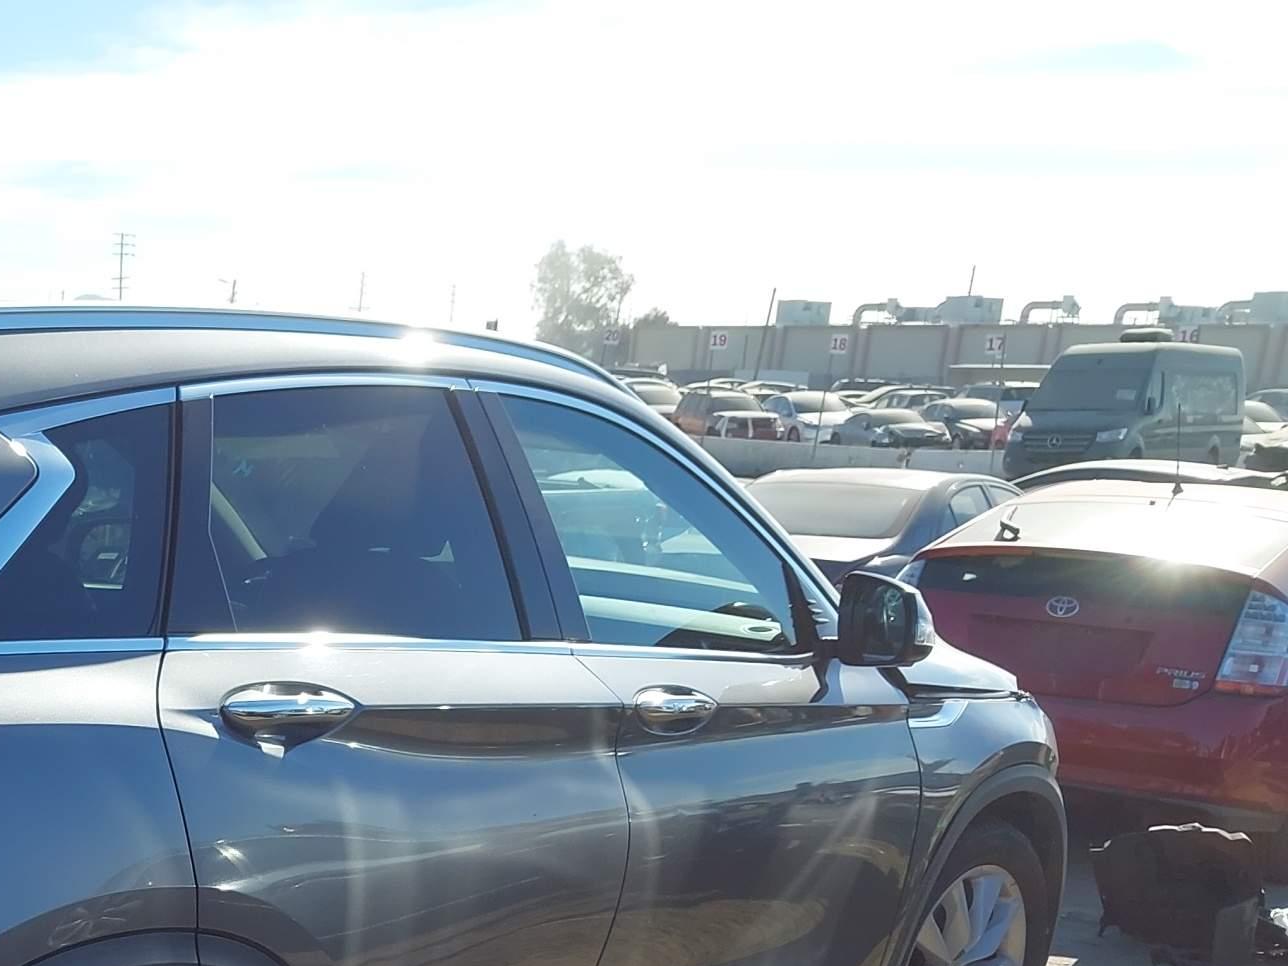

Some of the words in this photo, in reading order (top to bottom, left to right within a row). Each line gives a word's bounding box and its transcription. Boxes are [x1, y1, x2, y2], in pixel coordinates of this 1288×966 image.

[712, 334, 728, 347] 19
[831, 337, 847, 351] 18
[987, 336, 1005, 351] 17
